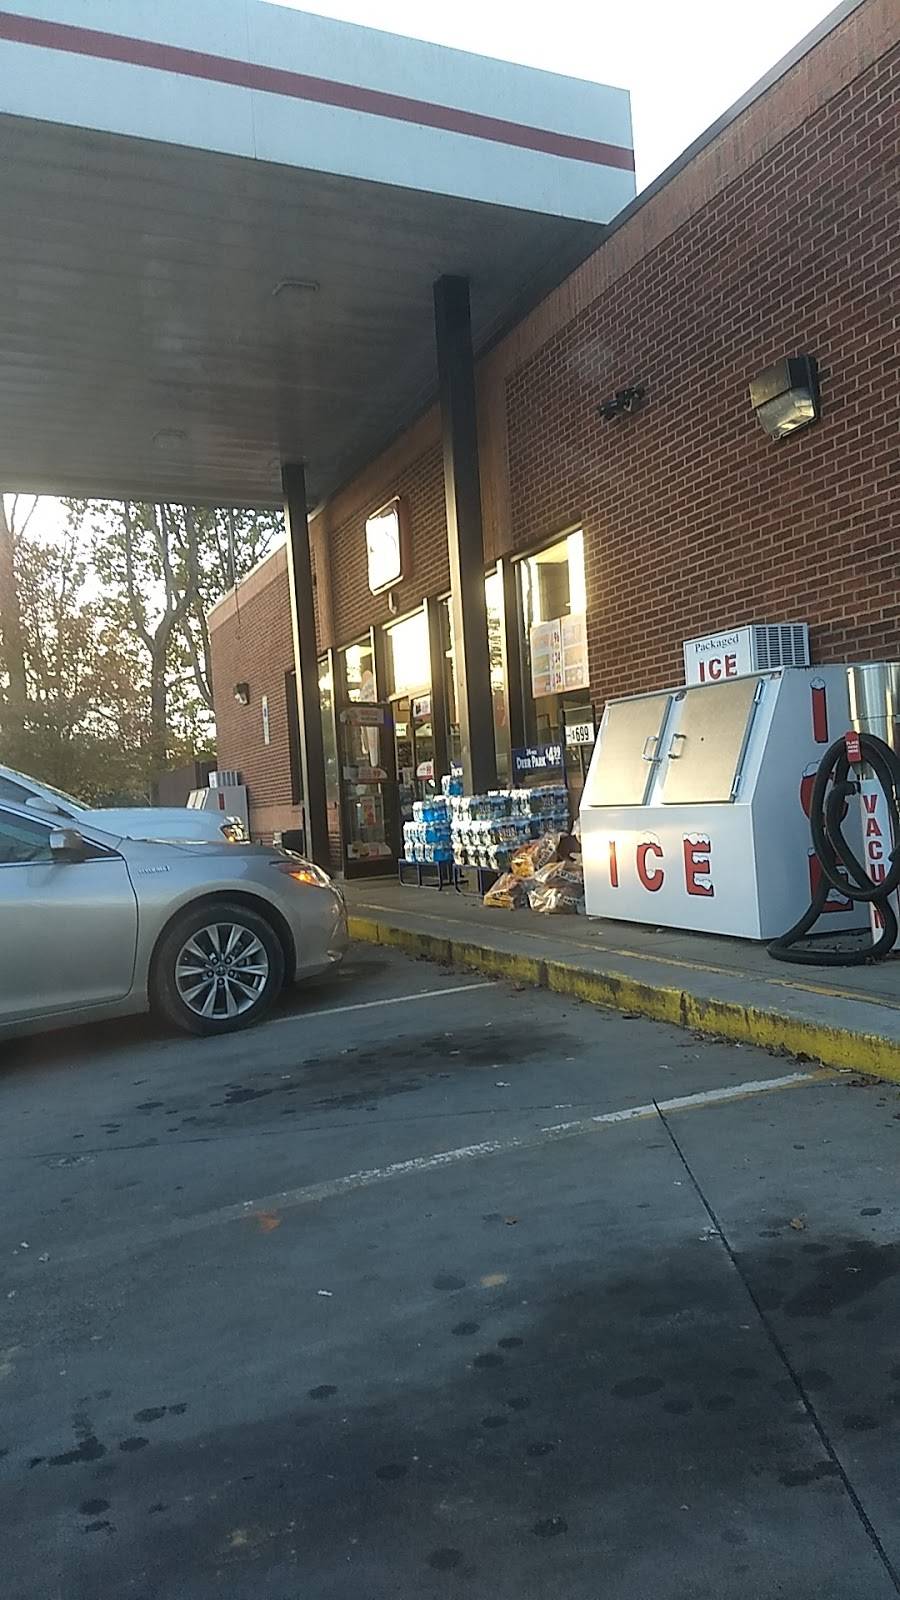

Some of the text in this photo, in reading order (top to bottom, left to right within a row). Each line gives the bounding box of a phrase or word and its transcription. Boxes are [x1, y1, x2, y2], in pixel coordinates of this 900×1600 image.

[695, 634, 739, 653] Packaged
[699, 652, 738, 682] ICE
[531, 755, 547, 768] PARK
[608, 832, 715, 898] ICE
